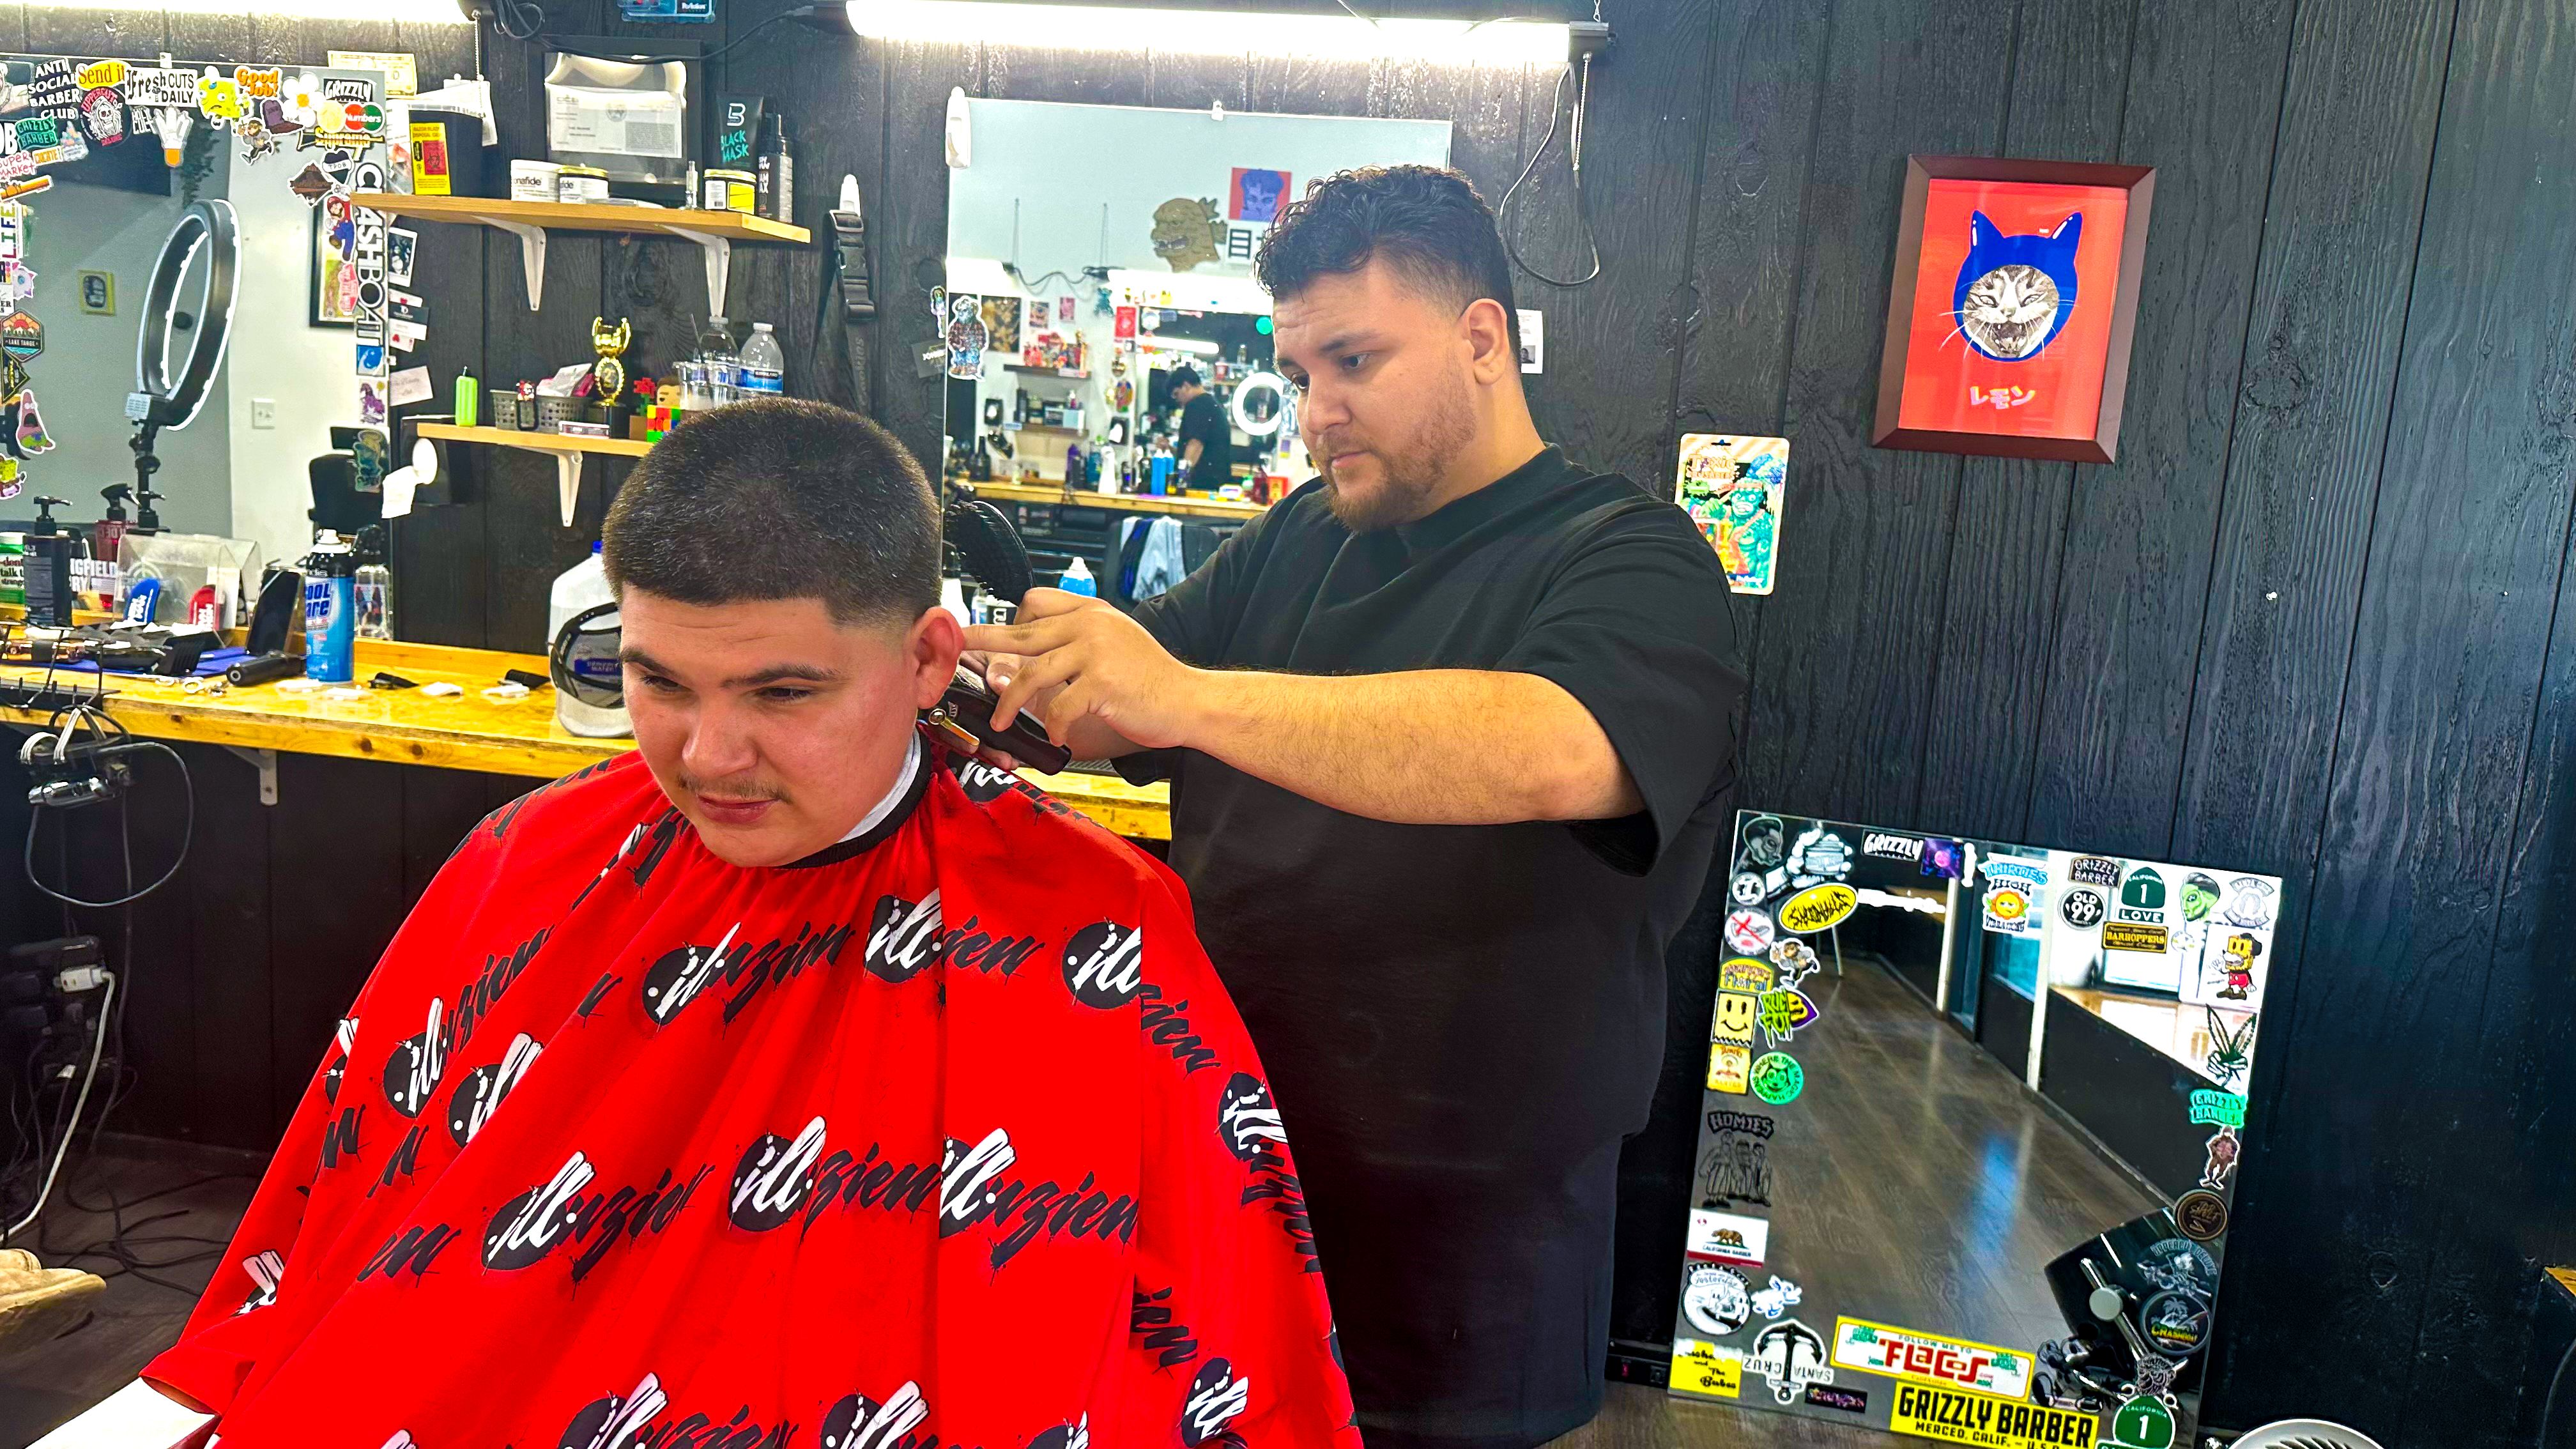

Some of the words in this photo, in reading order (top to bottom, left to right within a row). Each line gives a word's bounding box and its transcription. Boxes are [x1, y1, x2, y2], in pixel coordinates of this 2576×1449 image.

[35, 57, 70, 79] ANTI
[78, 65, 113, 84] Send
[236, 68, 279, 84] Good
[126, 69, 166, 100] Fresh
[169, 73, 194, 89] CUTS
[248, 83, 278, 97] Job!
[325, 79, 372, 98] GRIZZLY
[29, 89, 81, 107] BARBER
[161, 91, 194, 103] DAILY
[40, 107, 77, 120] CLUB
[721, 130, 746, 148] BLACK
[723, 144, 749, 162] MASK
[1970, 385, 2035, 410] レモン
[1864, 833, 1924, 861] GRIZZLY
[2074, 870, 2115, 885] BARBER
[1991, 878, 2032, 896] HIGH
[2140, 884, 2147, 904] 1
[2073, 892, 2098, 904] OLD
[2121, 910, 2162, 923] LOVE
[1708, 1112, 1774, 1139] HOMIES
[1898, 1334, 1938, 1348] FOLLOW
[1942, 1340, 1954, 1350] ME
[1959, 1344, 1973, 1354] TO
[1744, 1358, 1782, 1374] CRUZ
[1793, 1365, 1832, 1382] SANTA
[1898, 1386, 1993, 1430] GRIZZLY
[1997, 1403, 2093, 1449] BARBER
[2125, 1405, 2168, 1418] CALIFORNIA
[2139, 1414, 2149, 1440] 1
[1972, 1430, 2012, 1448] CALIF.
